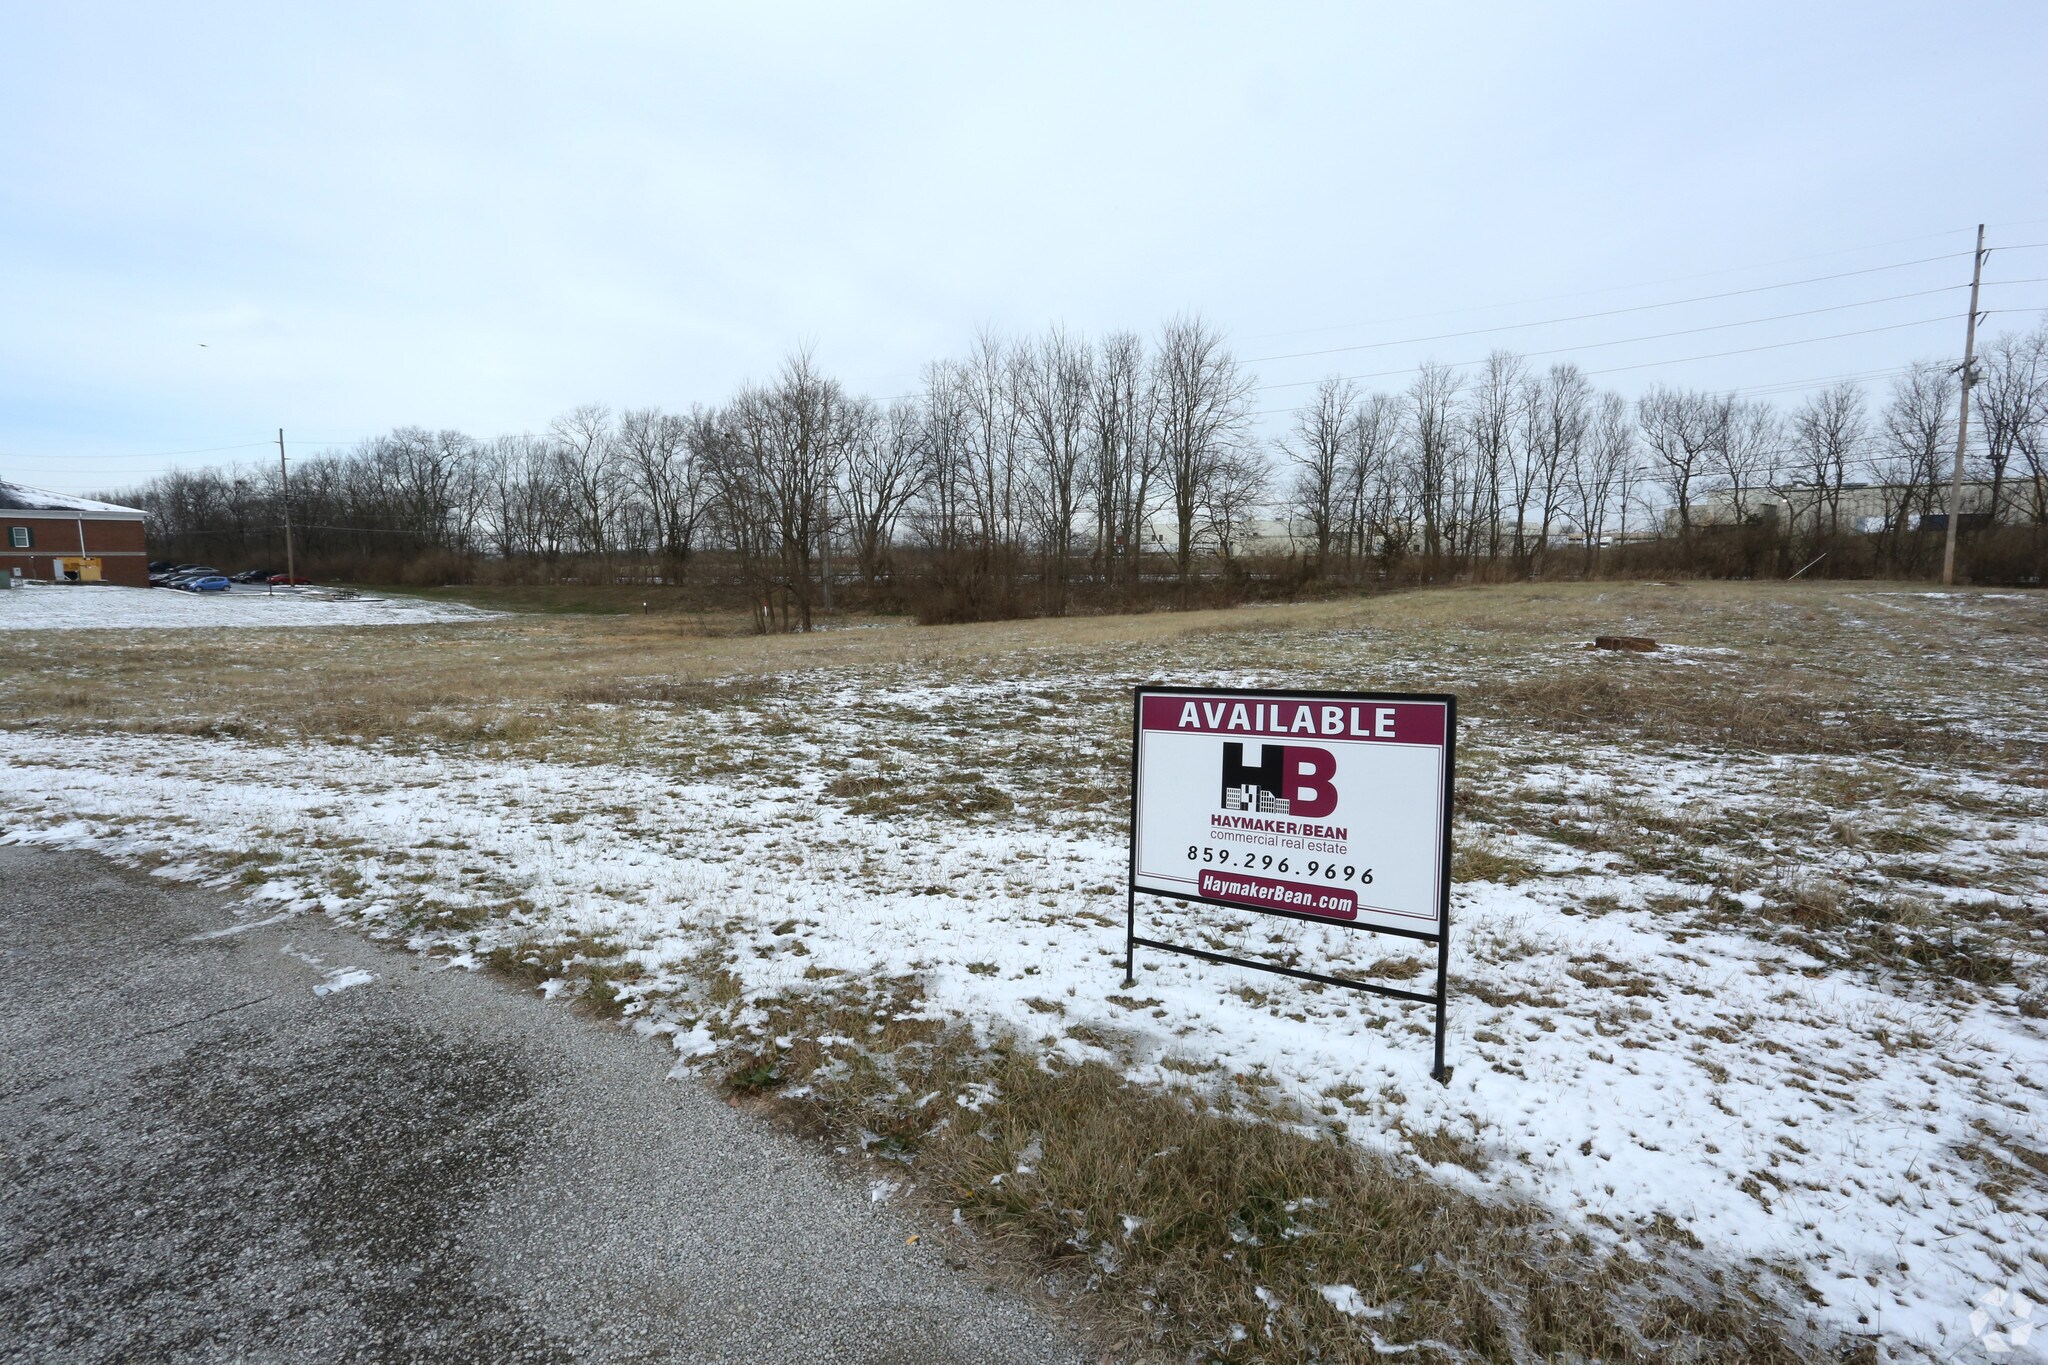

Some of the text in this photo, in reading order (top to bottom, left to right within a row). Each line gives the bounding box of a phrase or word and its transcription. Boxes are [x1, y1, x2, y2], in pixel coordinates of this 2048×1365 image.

[1178, 701, 1396, 738] AVAILABLE
[1221, 741, 1339, 818] HB
[1210, 829, 1348, 855] commercial real estate
[1211, 814, 1348, 840] HAYMAKER/BEAN
[1187, 846, 1374, 885] 859.296.9696
[1202, 875, 1353, 912] HaymakerBean.com
